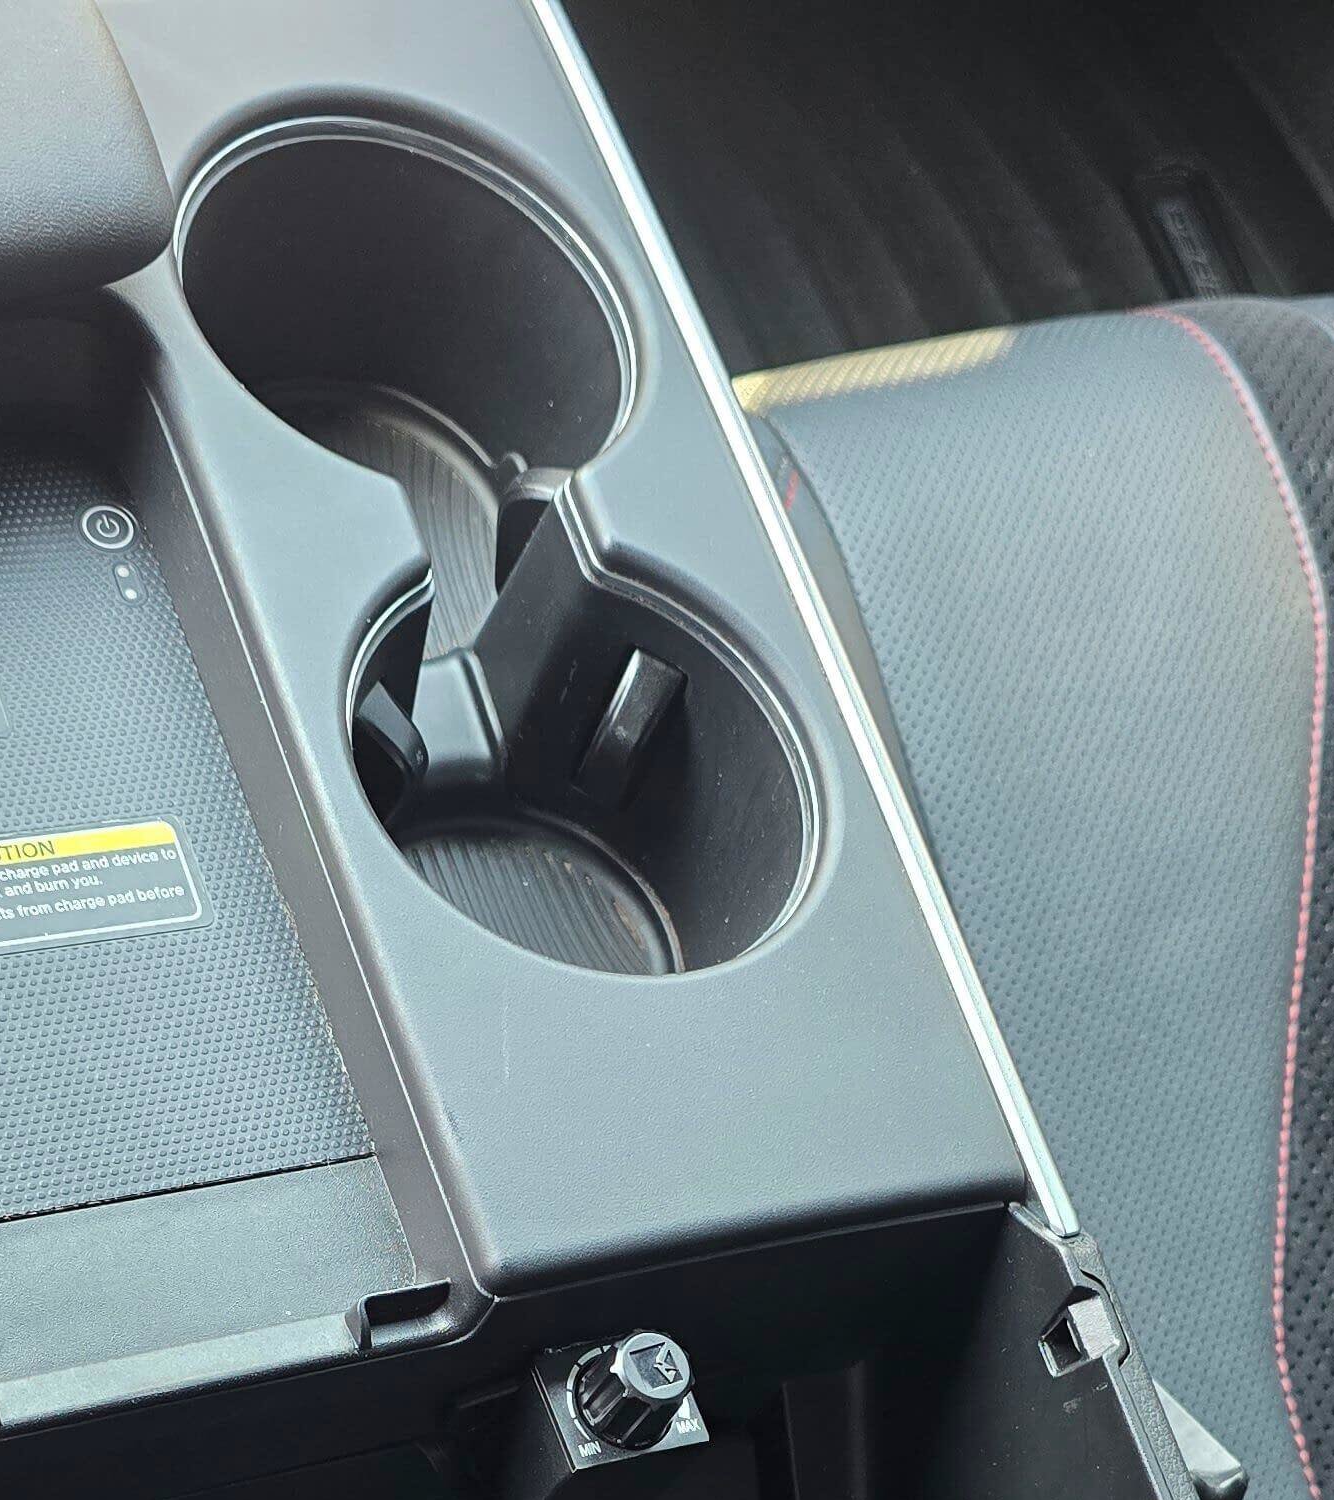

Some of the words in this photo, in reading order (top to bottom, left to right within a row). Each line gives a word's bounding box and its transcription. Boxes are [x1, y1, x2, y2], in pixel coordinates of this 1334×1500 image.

[52, 859, 80, 876] pad
[83, 855, 109, 871] and
[112, 849, 158, 867] device
[161, 847, 177, 860] to
[4, 882, 33, 898] and
[35, 877, 70, 894] burn
[71, 874, 104, 890] you.
[17, 899, 53, 918] from
[55, 894, 106, 914] charge
[107, 889, 135, 907] pad
[138, 883, 184, 902] before
[676, 1419, 701, 1434] MAX
[578, 1441, 601, 1457] MIN
